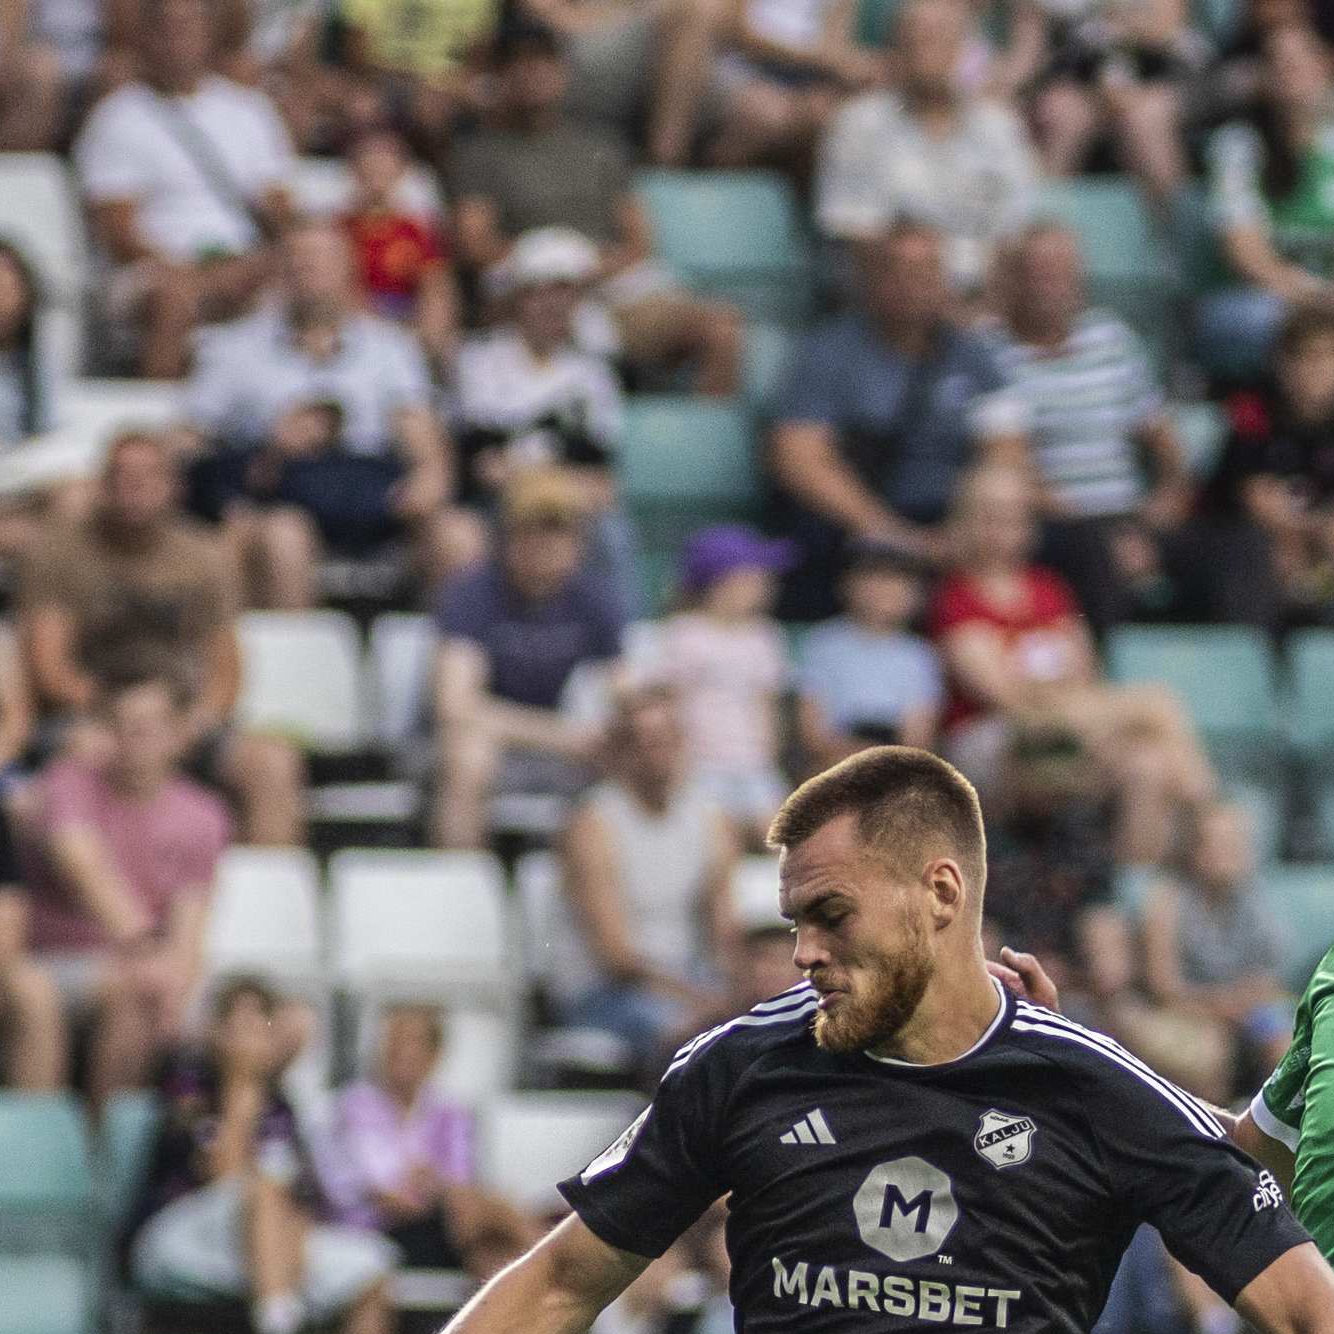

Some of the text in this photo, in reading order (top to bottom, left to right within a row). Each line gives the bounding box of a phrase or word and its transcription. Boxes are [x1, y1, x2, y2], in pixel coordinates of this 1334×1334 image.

[978, 1120, 1031, 1148] KALJU
[878, 1183, 934, 1234] M
[771, 1256, 1021, 1329] MARSBET
